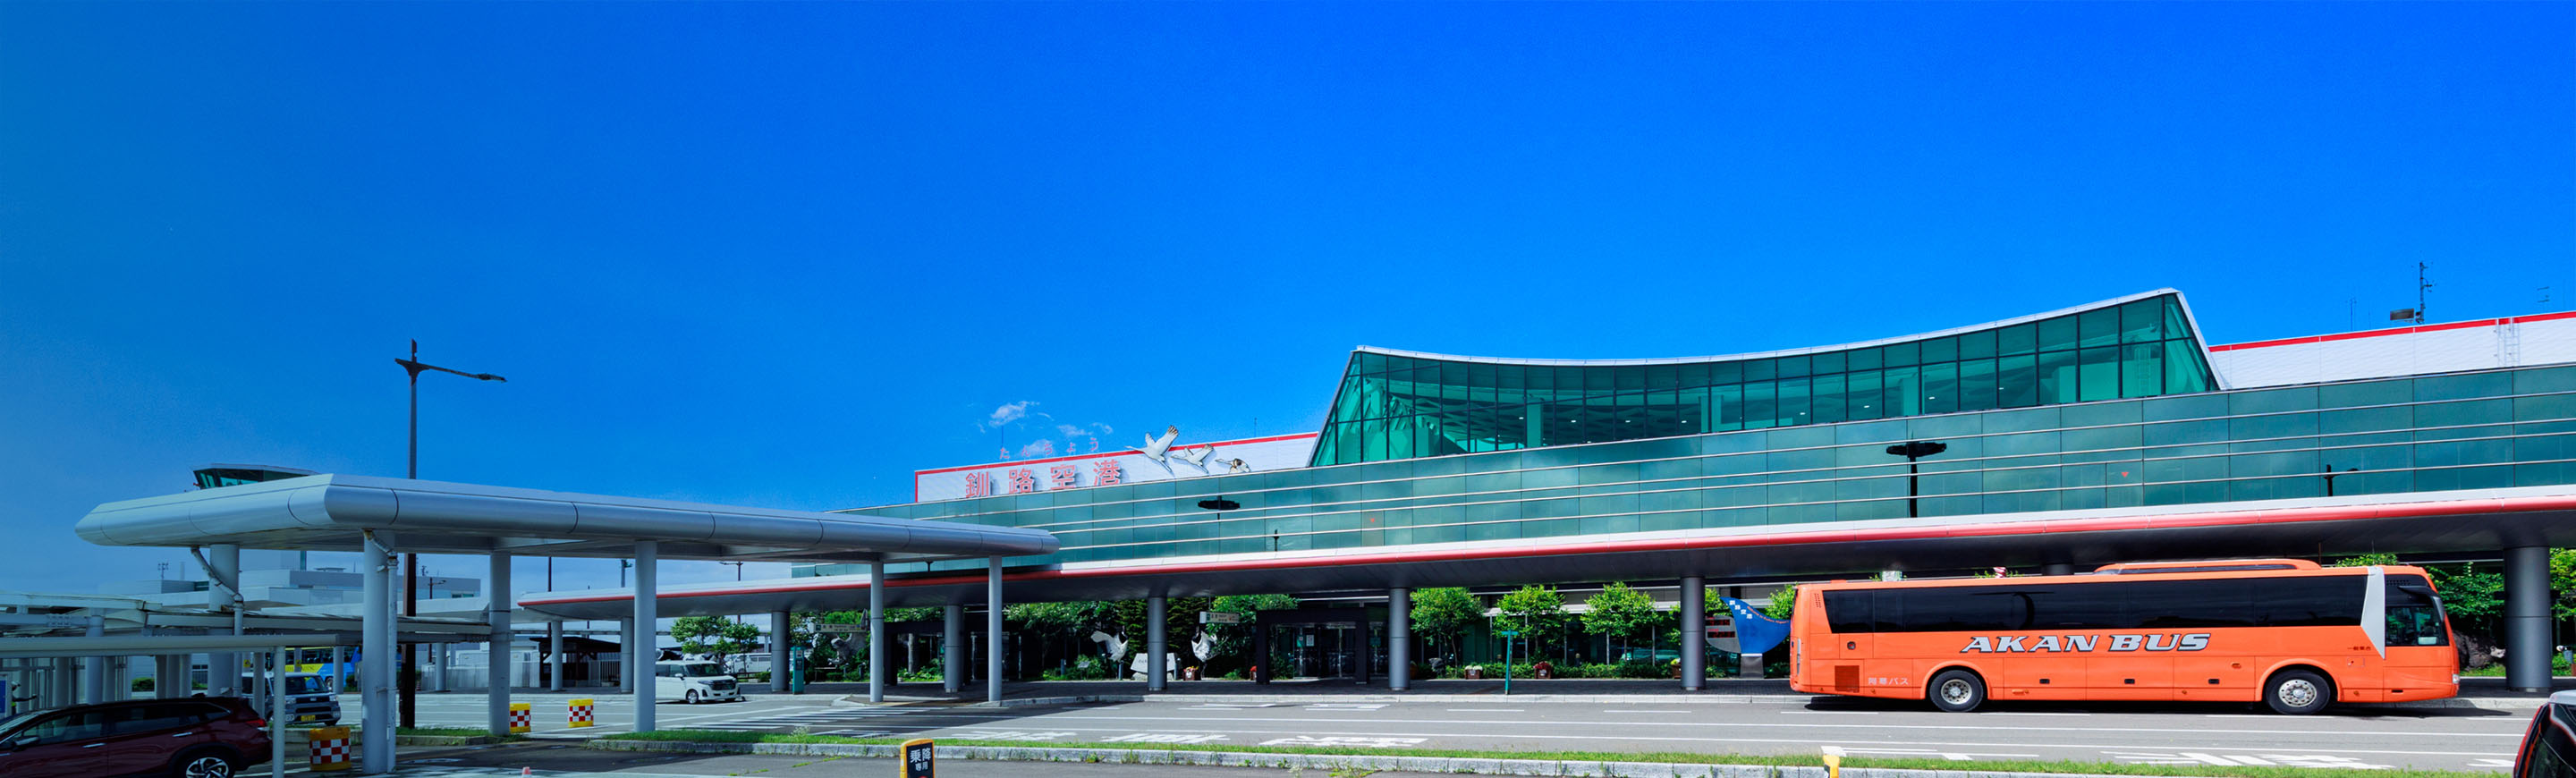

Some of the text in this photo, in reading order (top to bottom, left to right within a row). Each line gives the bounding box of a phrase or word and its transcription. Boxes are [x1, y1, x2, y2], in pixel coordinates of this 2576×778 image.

[999, 437, 1098, 459] たんちょう
[965, 459, 1120, 499] 釧路空港
[1959, 633, 2212, 654] AKAN BUS
[910, 748, 931, 763] 乗降
